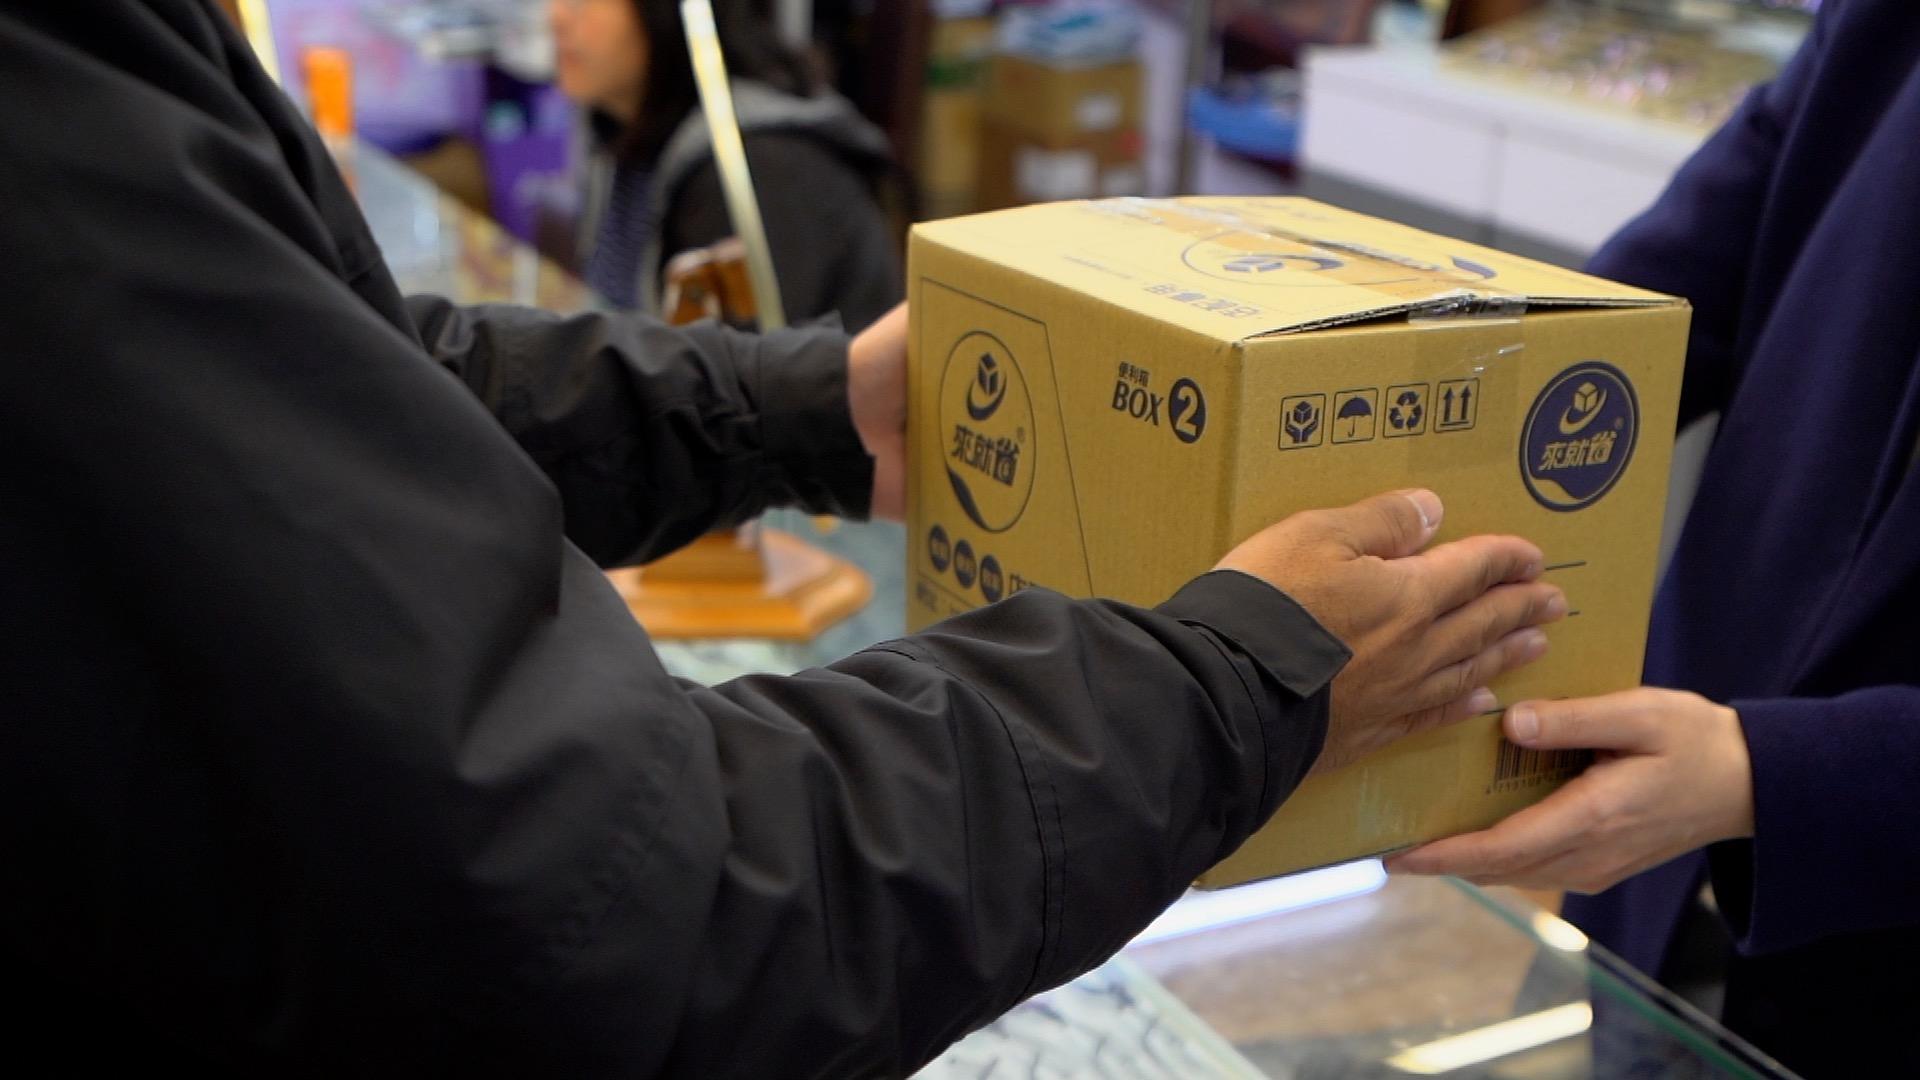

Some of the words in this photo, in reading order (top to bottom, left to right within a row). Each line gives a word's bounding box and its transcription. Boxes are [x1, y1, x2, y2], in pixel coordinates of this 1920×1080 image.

[1111, 379, 1164, 427] BOX
[1174, 383, 1200, 438] 2
[951, 424, 1021, 487] 來就省
[1537, 430, 1618, 472] 來就省
